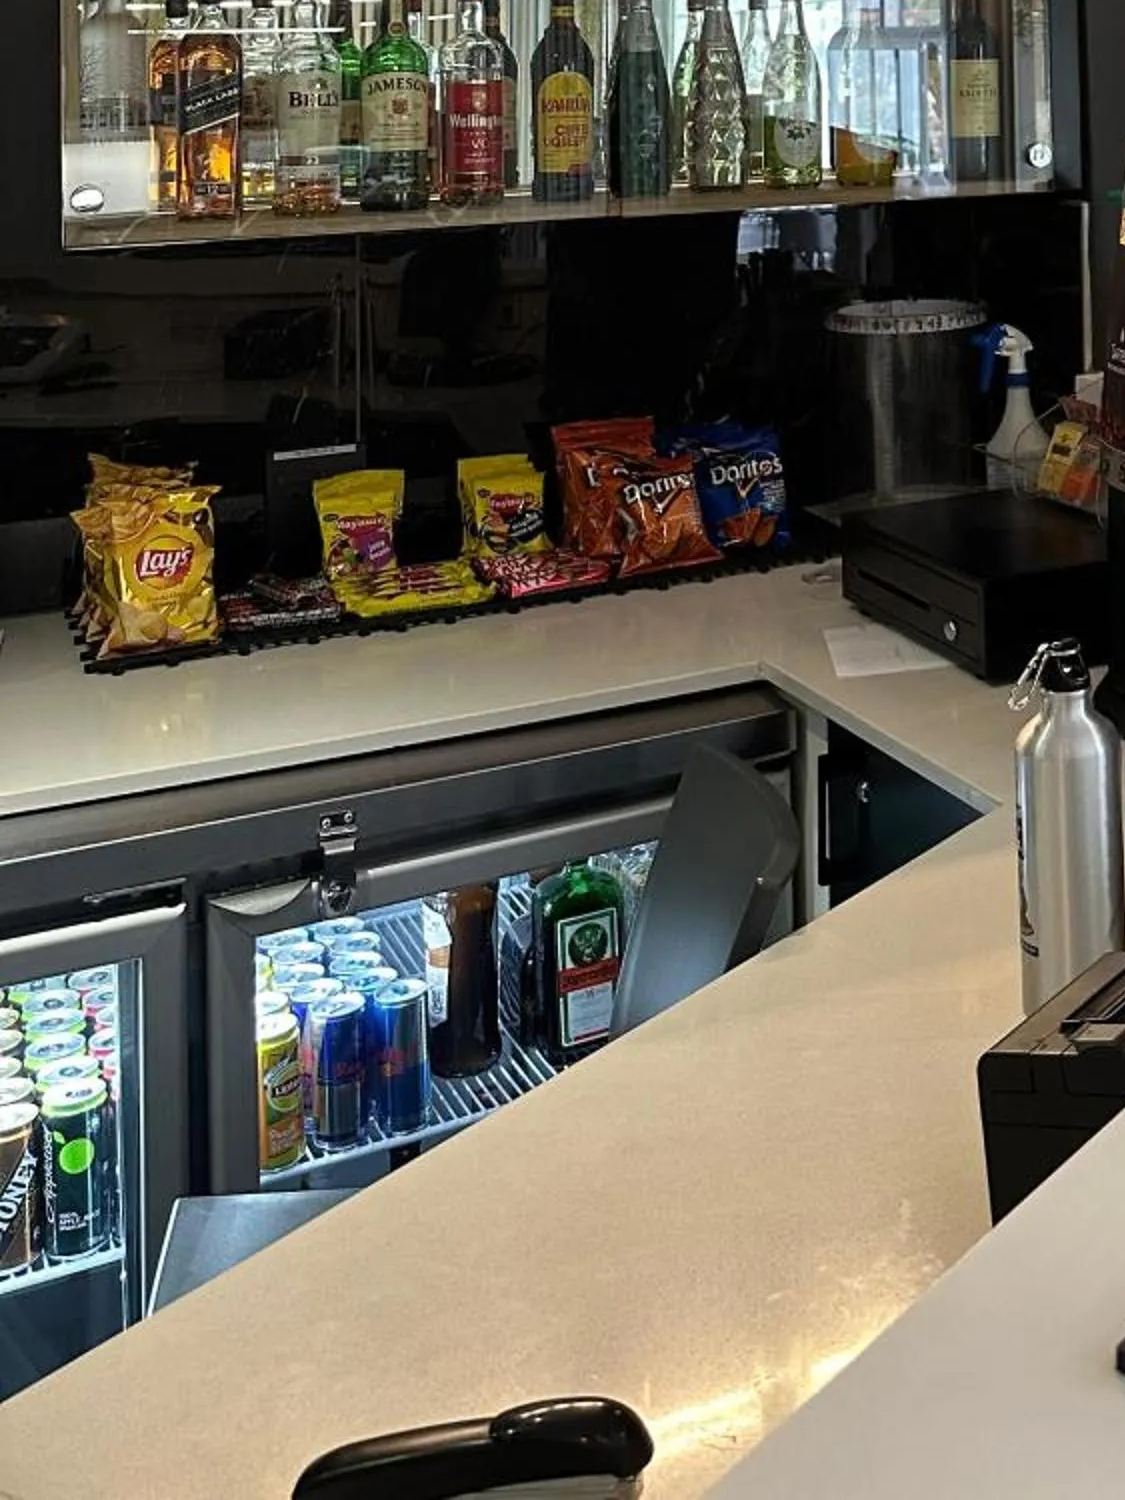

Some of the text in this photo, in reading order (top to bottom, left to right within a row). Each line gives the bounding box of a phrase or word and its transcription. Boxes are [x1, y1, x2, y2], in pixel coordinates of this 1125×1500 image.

[450, 113, 502, 130] Wellingt
[710, 455, 784, 485] Doritos
[139, 546, 193, 578] Lay's
[0, 1148, 39, 1232] ONEY
